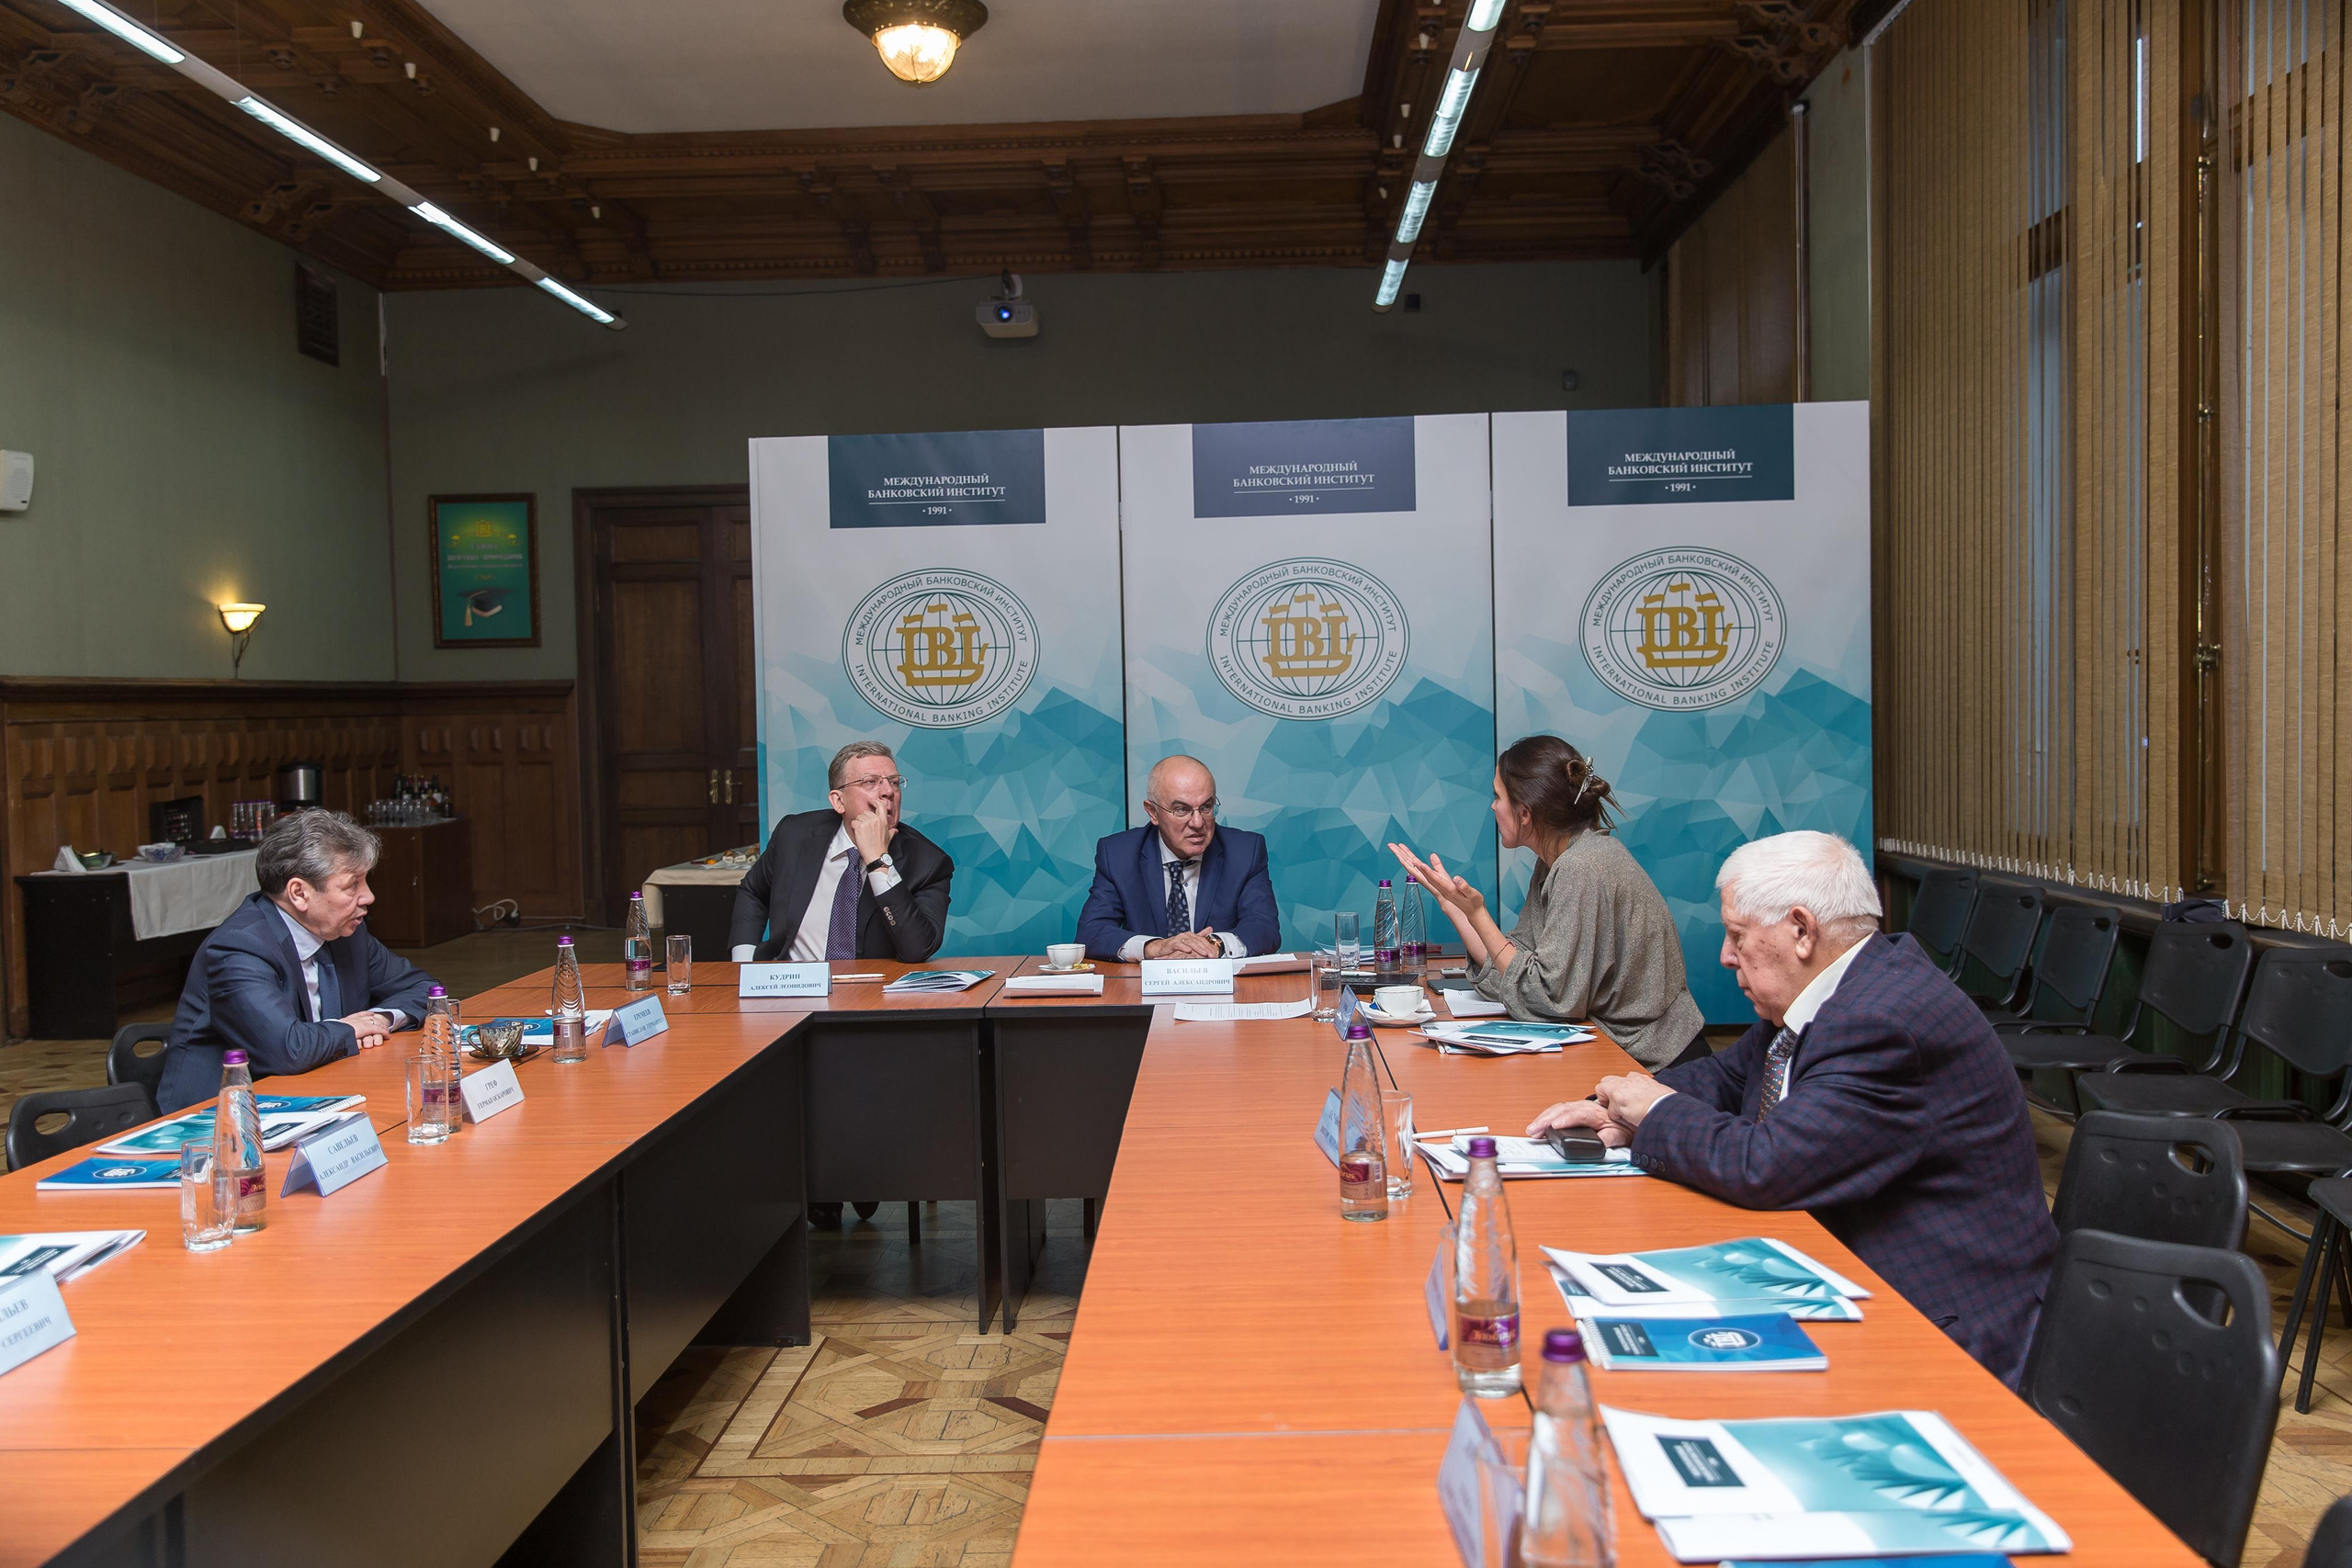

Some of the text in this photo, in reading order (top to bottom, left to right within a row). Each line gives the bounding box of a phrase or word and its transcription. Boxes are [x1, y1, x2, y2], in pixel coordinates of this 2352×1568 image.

[1624, 448, 1736, 463] МЕЖДУНАРОДНЫЙ
[1250, 461, 1358, 475] МЕЖДУНАРОДНЫЙ
[1608, 462, 1753, 476] БАНКОВСКИЙ ИНСТИТУТ
[884, 473, 989, 487] МЕЖДУНАРОДНЫЙ
[1233, 473, 1375, 488] БАНКОВСКИЙ ИНСТИТУТ
[867, 486, 1006, 499] БАНКОВСКИЙ ИНСТИТУТ
[1592, 554, 1773, 626] МЕЖДУНАРОДНЫЙ БАНКОВСКИЙ ИНСТИТУТ
[1220, 565, 1396, 637] МЕЖДУНАРОДНЫЙ БАНКОВСКИЙ ИНСТИТУТ
[855, 576, 1027, 646] МЕЖДУНАРОДНЫЙ БАНКОВСКИЙ ИНСТИТУТ
[1592, 640, 1774, 705] INTERNATIONAL BANKING INSTITUTE
[1220, 649, 1397, 715] INTERNATIONAL BANKING INSTITUTE
[855, 660, 1028, 723] INTERNATIONAL BANKING INSTITUTE
[769, 973, 800, 981] КУДРИН
[1166, 966, 1208, 975] ВАСИЛЬЕВ
[750, 982, 821, 991] АЛЕКСЕЙ ЛЕОНИДОВИЧ
[1144, 977, 1230, 987] СЕРГЕЙ АЛЕКСАНДРОВИЧ
[484, 1079, 498, 1091] ГРЕФ
[477, 1086, 514, 1110] ГЕРМАН ОСКАРОВИЧ
[327, 1134, 359, 1155] САВЕЛЬЕВ
[318, 1143, 380, 1181] АЛЕКСАНДР ВАСИЛЬЕВИЧ
[0, 1299, 29, 1323] ЛЬЕВ
[2, 1315, 52, 1348] СЕРГЕЕВИЧ
